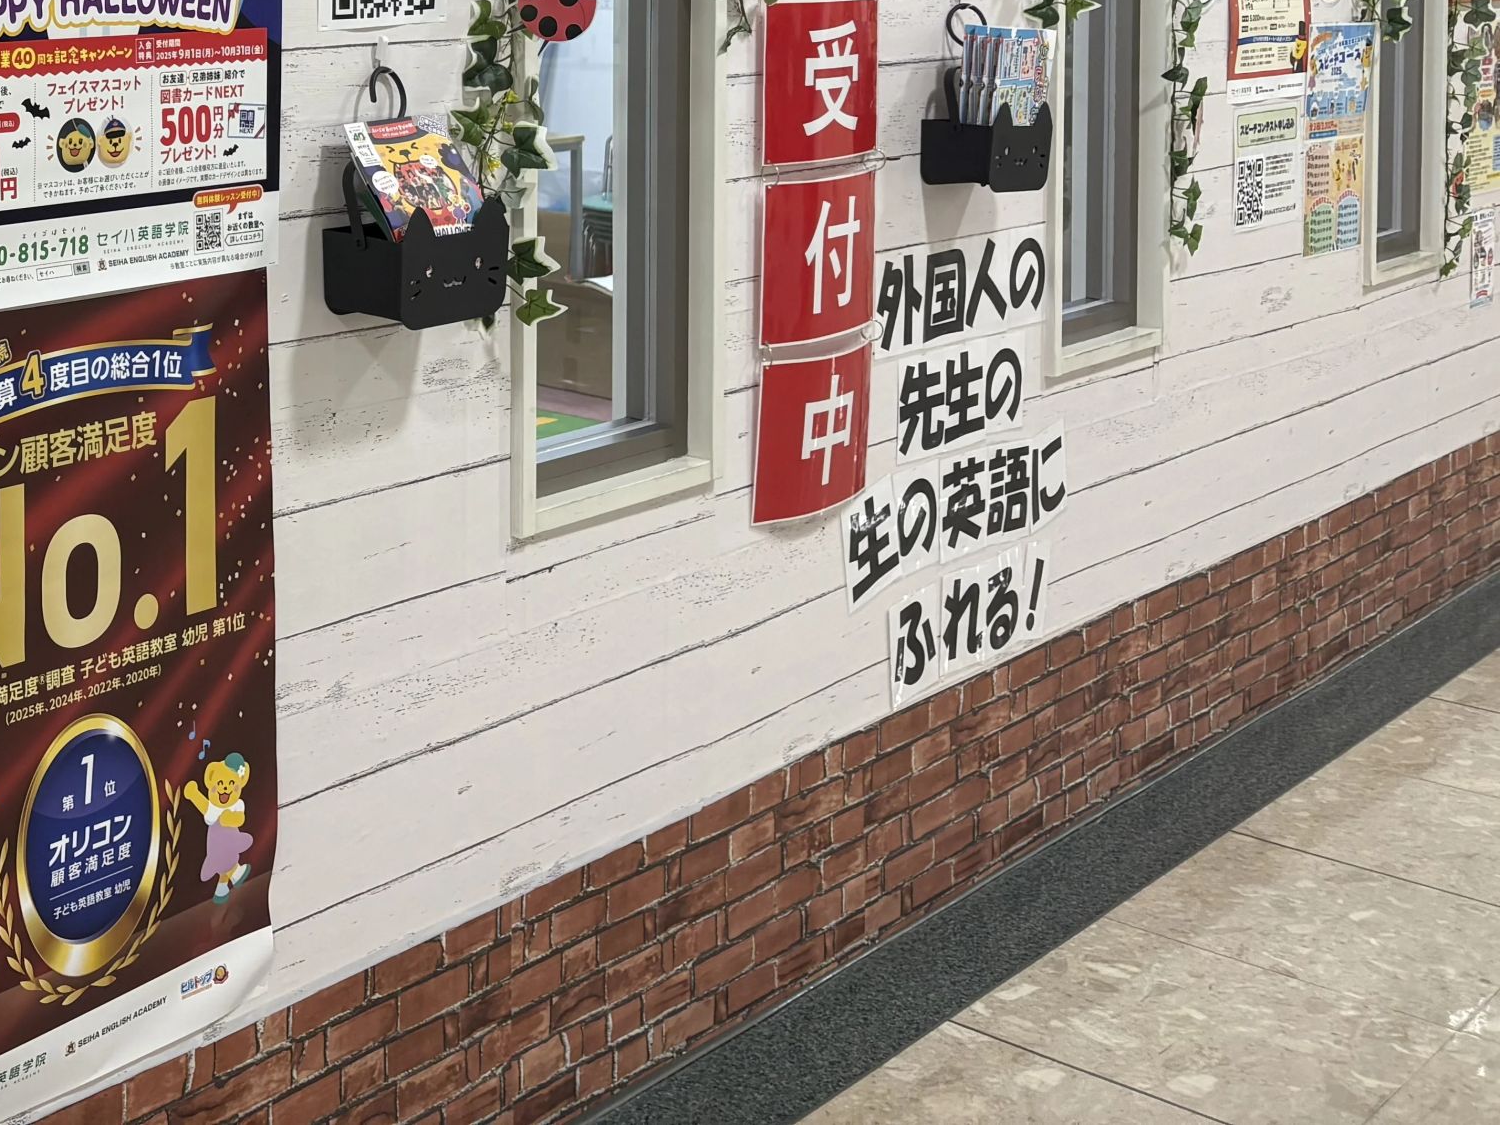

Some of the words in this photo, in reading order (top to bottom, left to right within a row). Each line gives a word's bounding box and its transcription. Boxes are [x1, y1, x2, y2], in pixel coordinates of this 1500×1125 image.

[155, 38, 181, 48] 受付期間
[47, 76, 142, 97] フェイスマスコット
[162, 72, 185, 84] お友達
[191, 70, 221, 83] 兄弟姉妹
[224, 69, 246, 80] 紹介で
[64, 95, 124, 115] プレゼント!
[160, 84, 245, 104] 図書カードNEXT
[160, 104, 212, 147] 500
[160, 144, 217, 165] プレゼント!
[0, 176, 17, 202] 円
[196, 190, 261, 205] 無料体験レッスン受付中!
[227, 220, 265, 232] お近くの教室へ
[237, 211, 254, 221] まずは
[96, 220, 189, 247] セイハ英語学院
[229, 232, 262, 244] 詳しくはコチラ
[108, 257, 128, 268] SEIHA
[129, 253, 157, 265] ENGLISH
[158, 249, 189, 262] ACADEMY
[39, 269, 55, 278] セイハ
[876, 237, 1046, 352] 外国人の
[898, 347, 1023, 456] 先生の
[848, 435, 1067, 604] 生の英語に
[894, 558, 1046, 686] ふれる!
[80, 632, 179, 680] 子ども英語教室
[181, 622, 209, 648] 幼児
[212, 611, 247, 638] 第1位
[5, 663, 163, 727] (2025年、2024年、2022年、2020年)
[61, 753, 117, 813] 第1位
[48, 813, 134, 868] オリコン
[49, 841, 133, 889] 顧客満足度
[52, 886, 113, 921] 子ども英語教室
[114, 878, 132, 897] 幼児
[180, 968, 214, 995] ヒルトップ
[77, 1031, 101, 1048] SEIHA
[101, 1013, 132, 1036] ENGLISH
[133, 995, 168, 1020] ACADEMY
